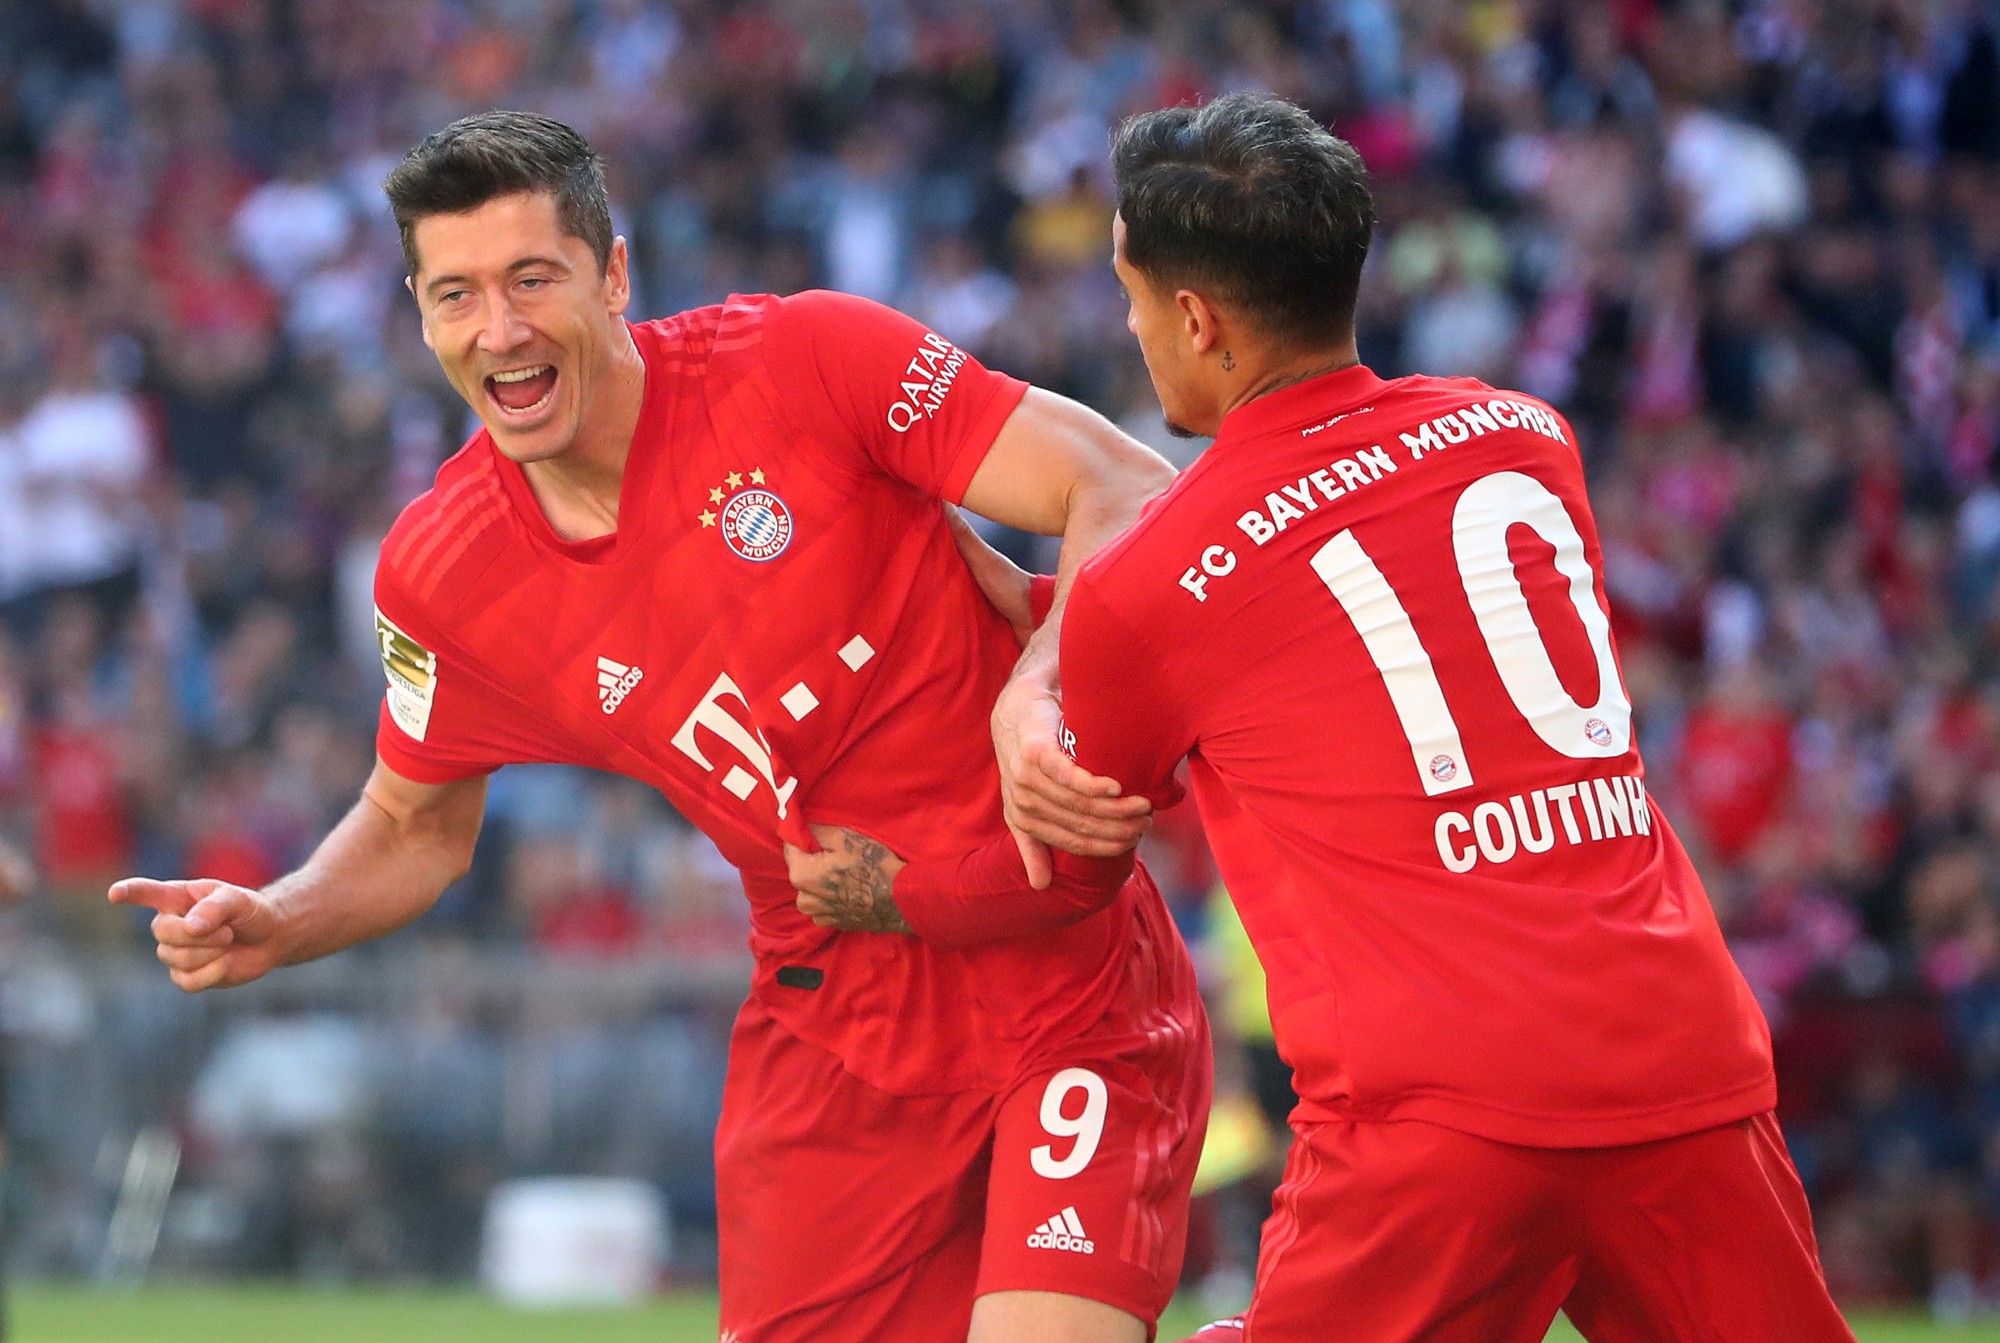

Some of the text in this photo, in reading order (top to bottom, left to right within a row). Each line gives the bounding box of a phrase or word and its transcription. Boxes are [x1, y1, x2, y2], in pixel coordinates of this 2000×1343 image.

[887, 333, 952, 432] QATAR
[923, 347, 967, 419] AIRWAYS
[726, 494, 775, 539] FC BAYERN
[1178, 400, 1568, 602] FC BAYERN MÜNCHEN
[1308, 471, 1632, 797] 10
[602, 666, 643, 715] adidas
[1434, 775, 1652, 874] COUTINH
[1030, 1067, 1109, 1180] 9
[1026, 1232, 1095, 1255] adidas
